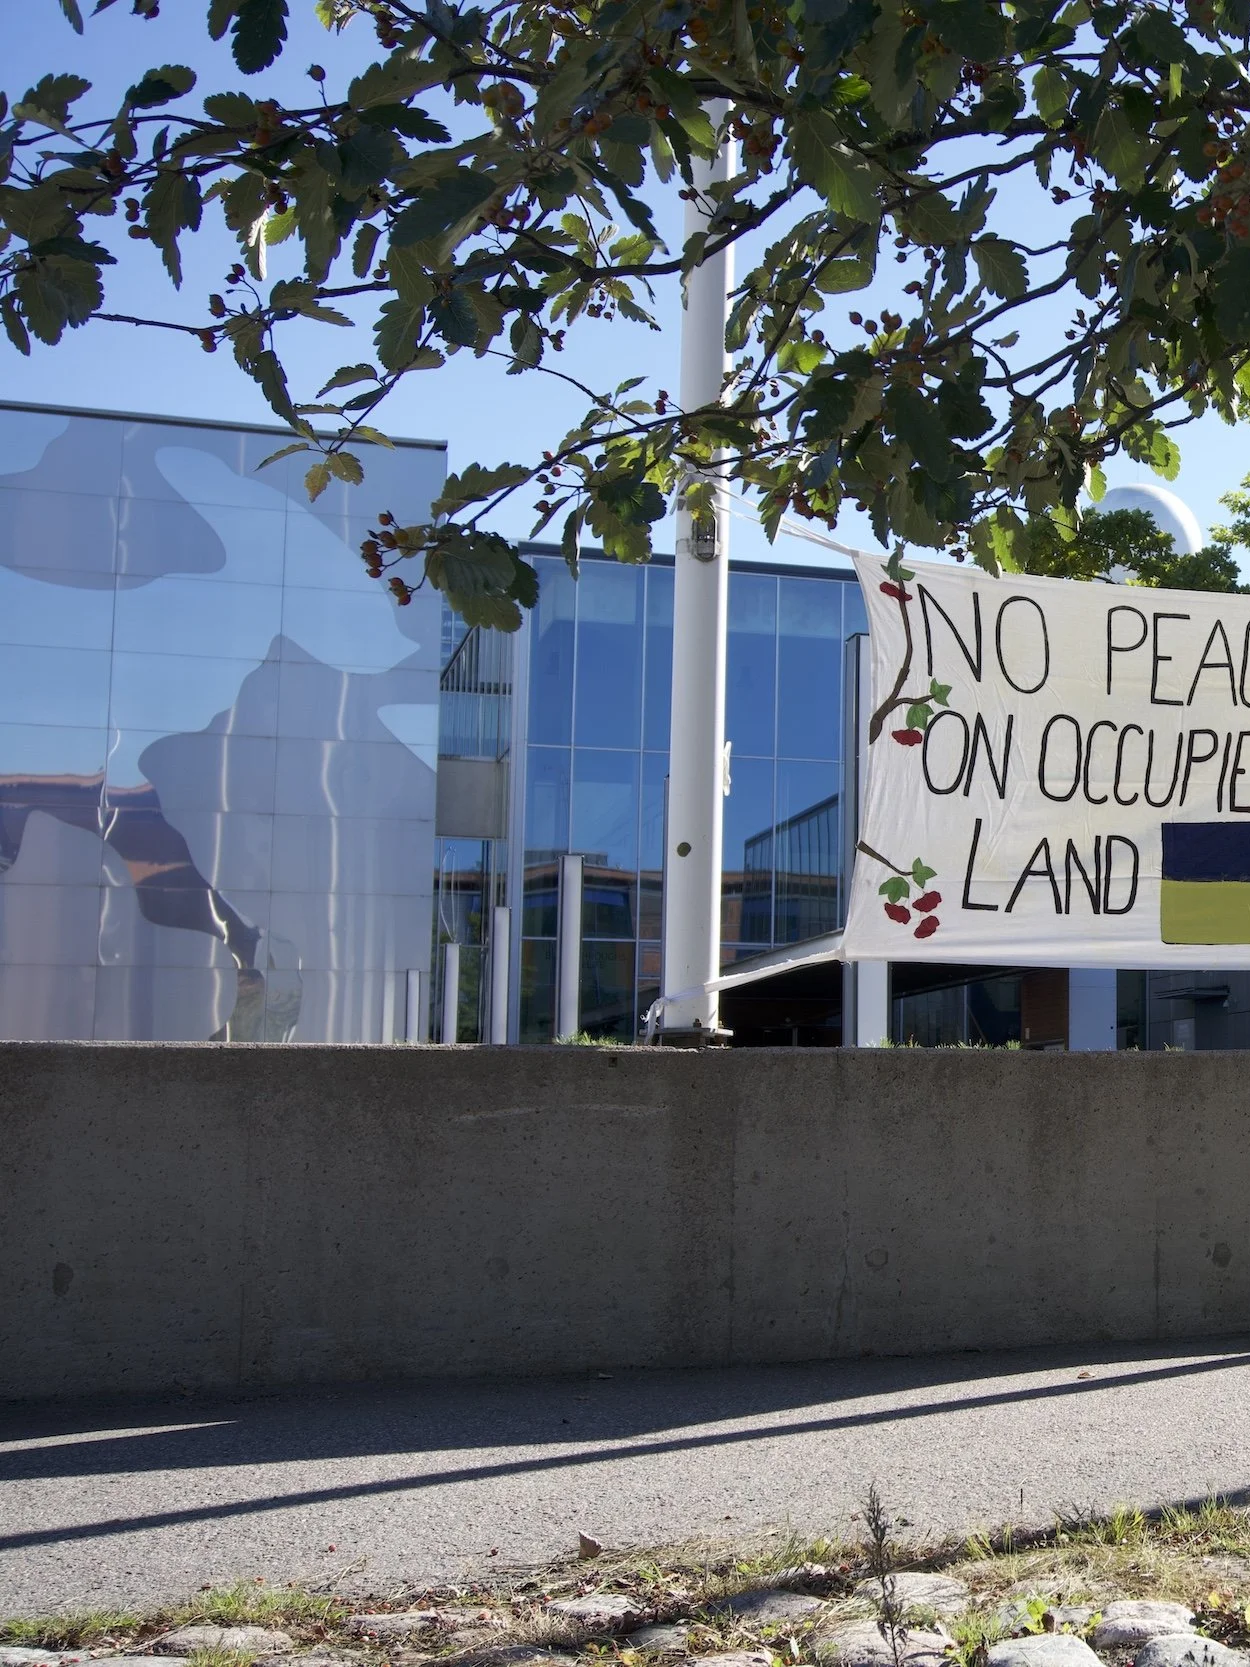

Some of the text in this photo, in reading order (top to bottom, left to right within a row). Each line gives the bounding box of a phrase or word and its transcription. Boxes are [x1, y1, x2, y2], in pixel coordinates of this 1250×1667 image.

[916, 583, 1050, 694] NO
[922, 709, 1014, 800] ON
[961, 818, 1140, 915] LAND
